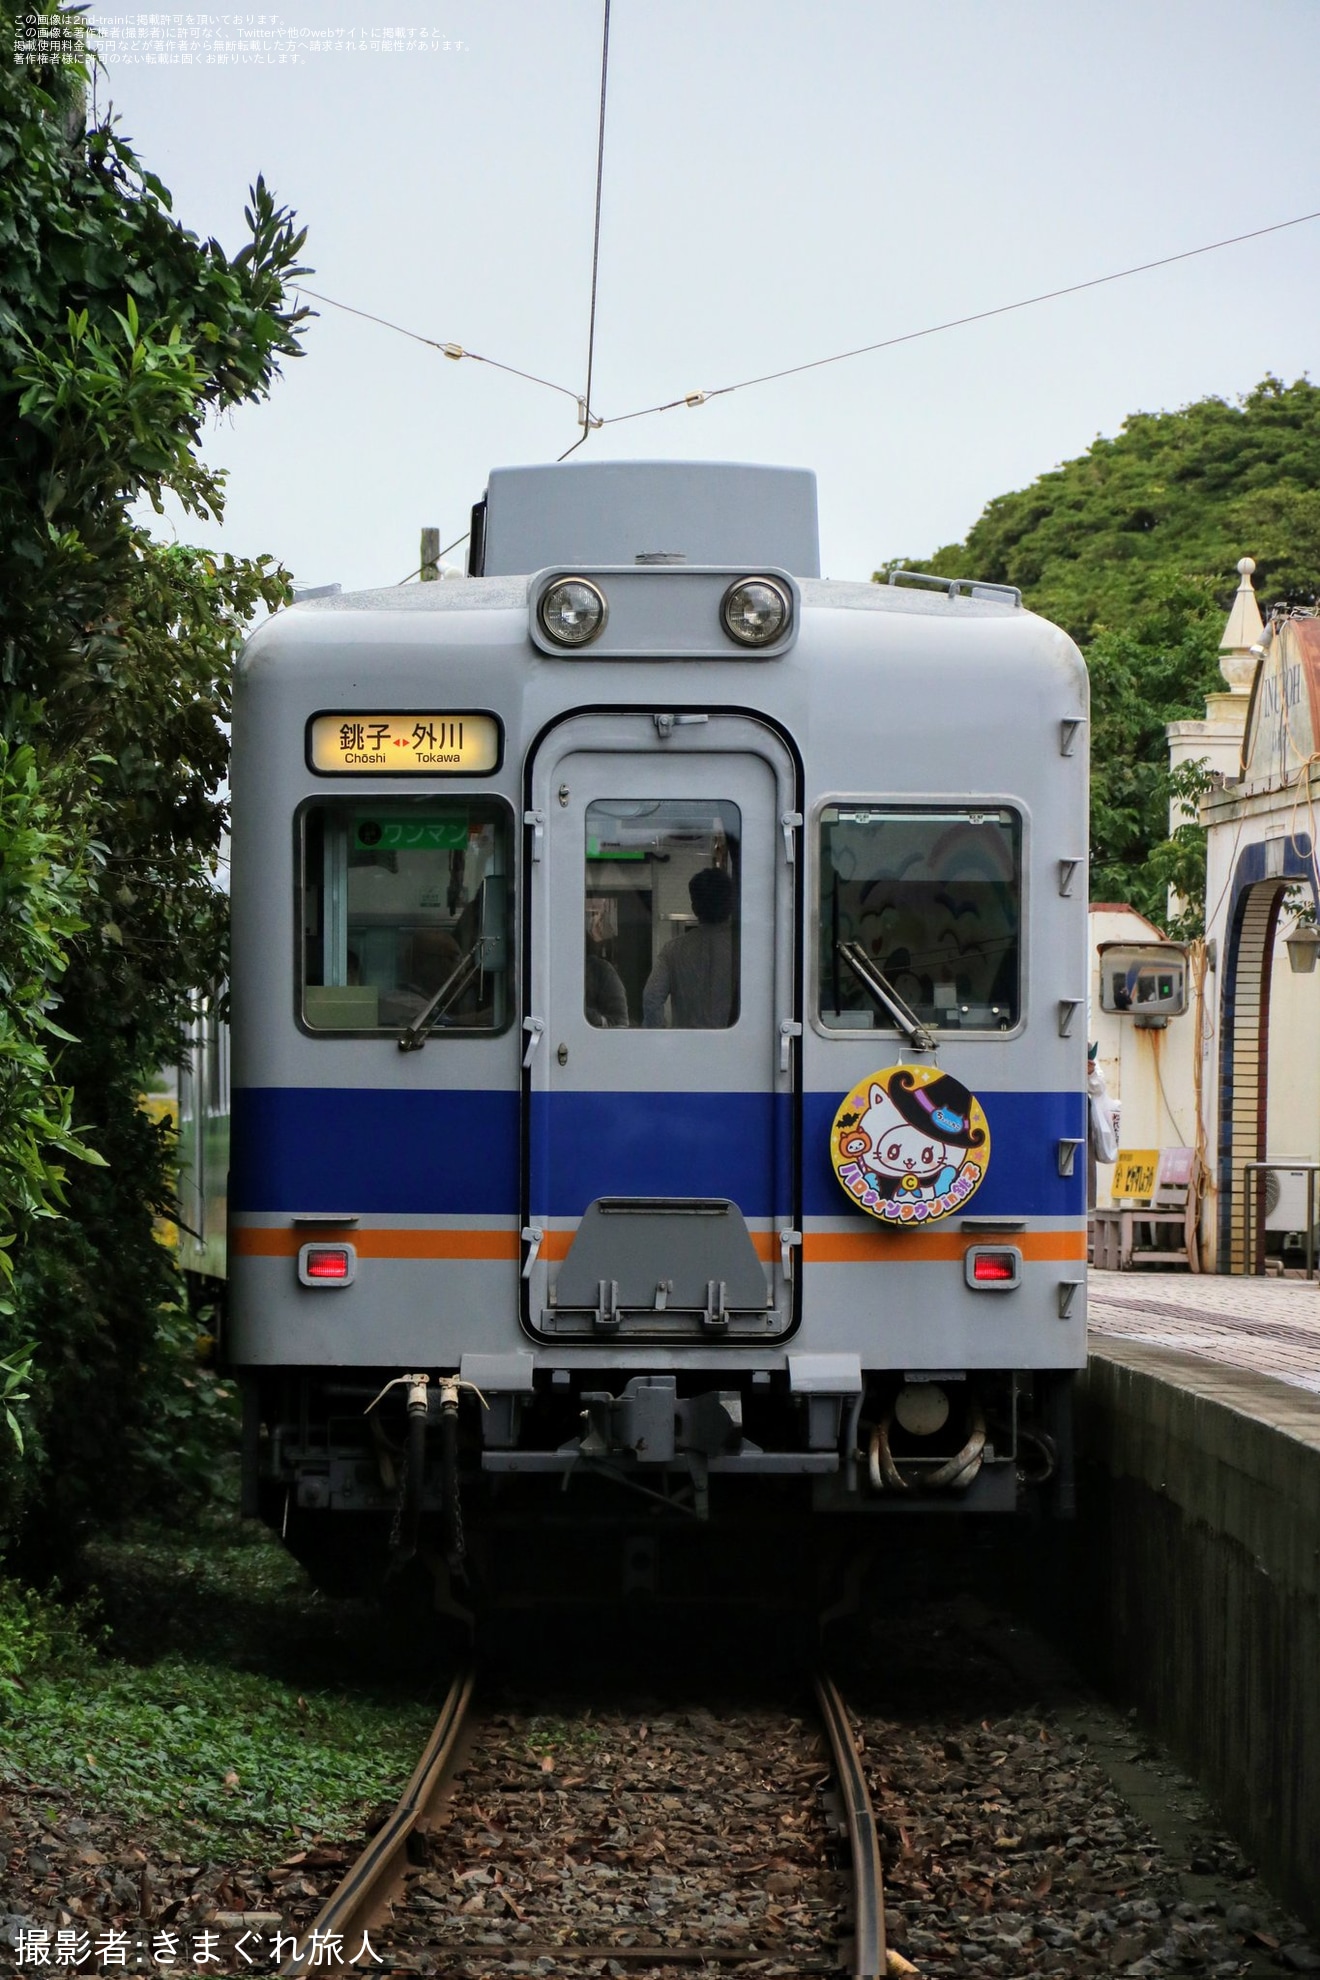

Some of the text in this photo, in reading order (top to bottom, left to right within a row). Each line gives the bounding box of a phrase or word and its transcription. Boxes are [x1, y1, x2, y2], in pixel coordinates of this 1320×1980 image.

[339, 722, 463, 750] 銚子 外川
[345, 753, 461, 763] Chōshi Tokawa
[384, 824, 466, 843] ワンマン
